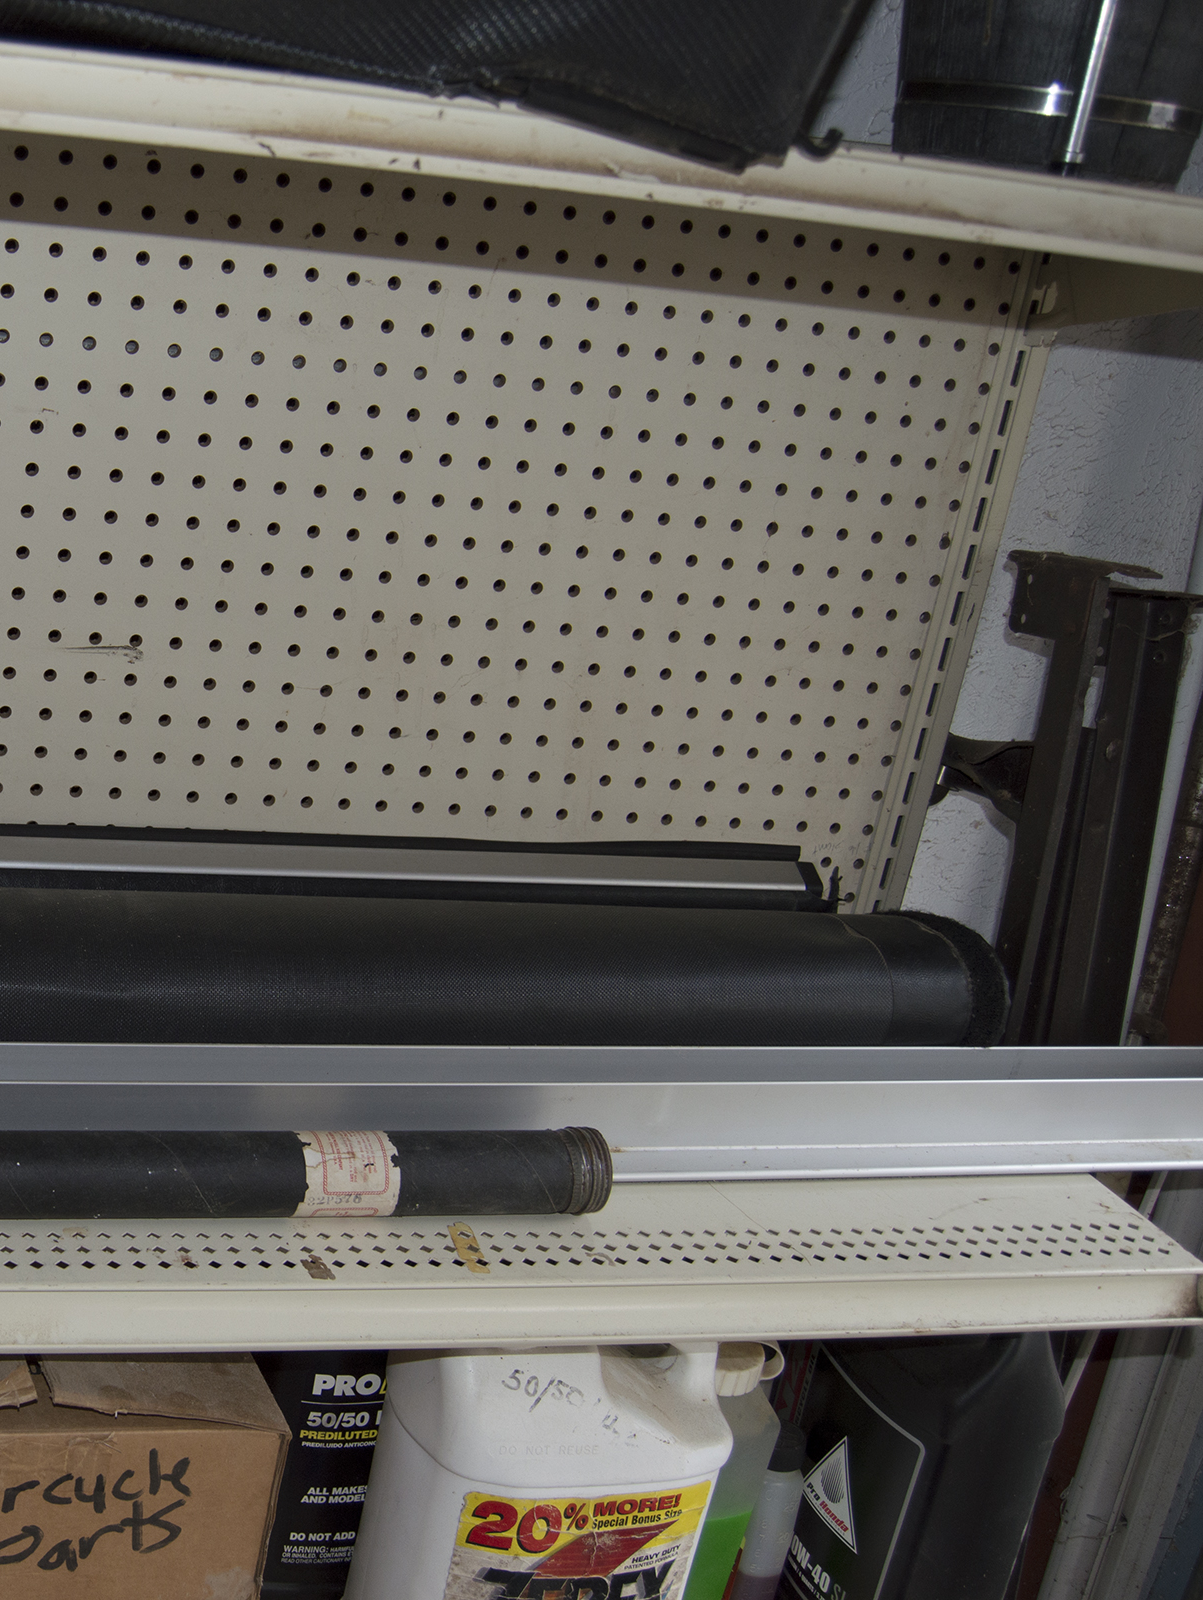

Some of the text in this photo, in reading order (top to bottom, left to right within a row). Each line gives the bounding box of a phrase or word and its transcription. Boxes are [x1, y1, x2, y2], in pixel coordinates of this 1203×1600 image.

[501, 1368, 585, 1412] 50/50
[306, 1411, 370, 1429] 50/50
[299, 1429, 378, 1440] PREDILUTED
[498, 1444, 599, 1455] DO NOT REUSE
[307, 1486, 329, 1495] ALL
[300, 1495, 326, 1504] AND
[592, 1493, 683, 1518] MORE!
[806, 1481, 821, 1502] Pro
[819, 1500, 850, 1533] Honda
[591, 1509, 683, 1530] Special Bonus Size
[465, 1500, 589, 1554] 20%
[289, 1531, 356, 1541] DO NOT ADD
[283, 1544, 329, 1553] WARNING:
[631, 1544, 682, 1564] HEAVY DUTY
[623, 1560, 654, 1571] PATENTED
